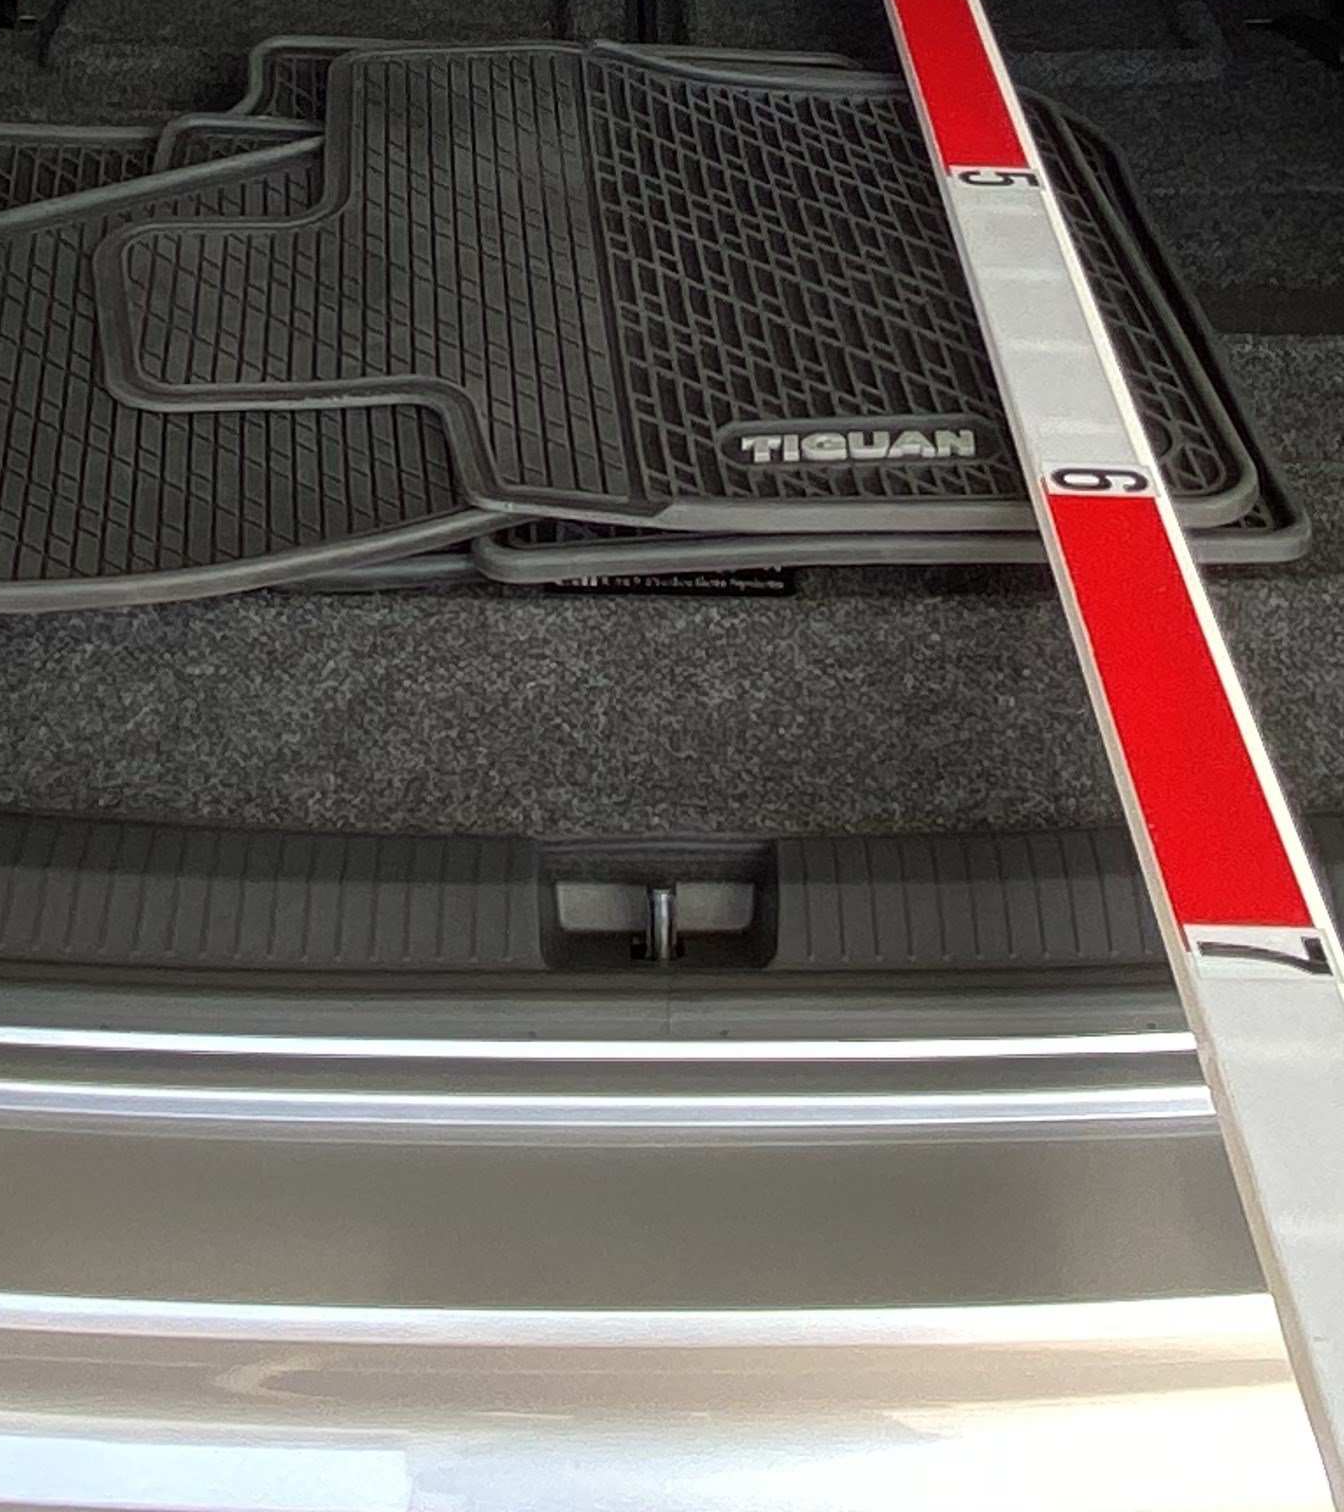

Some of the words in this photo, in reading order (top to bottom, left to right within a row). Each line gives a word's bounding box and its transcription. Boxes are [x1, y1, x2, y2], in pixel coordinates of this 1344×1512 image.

[958, 171, 1040, 187] 5
[741, 430, 976, 463] TIGUAN
[1051, 467, 1149, 494] 6
[1196, 935, 1334, 977] 7
